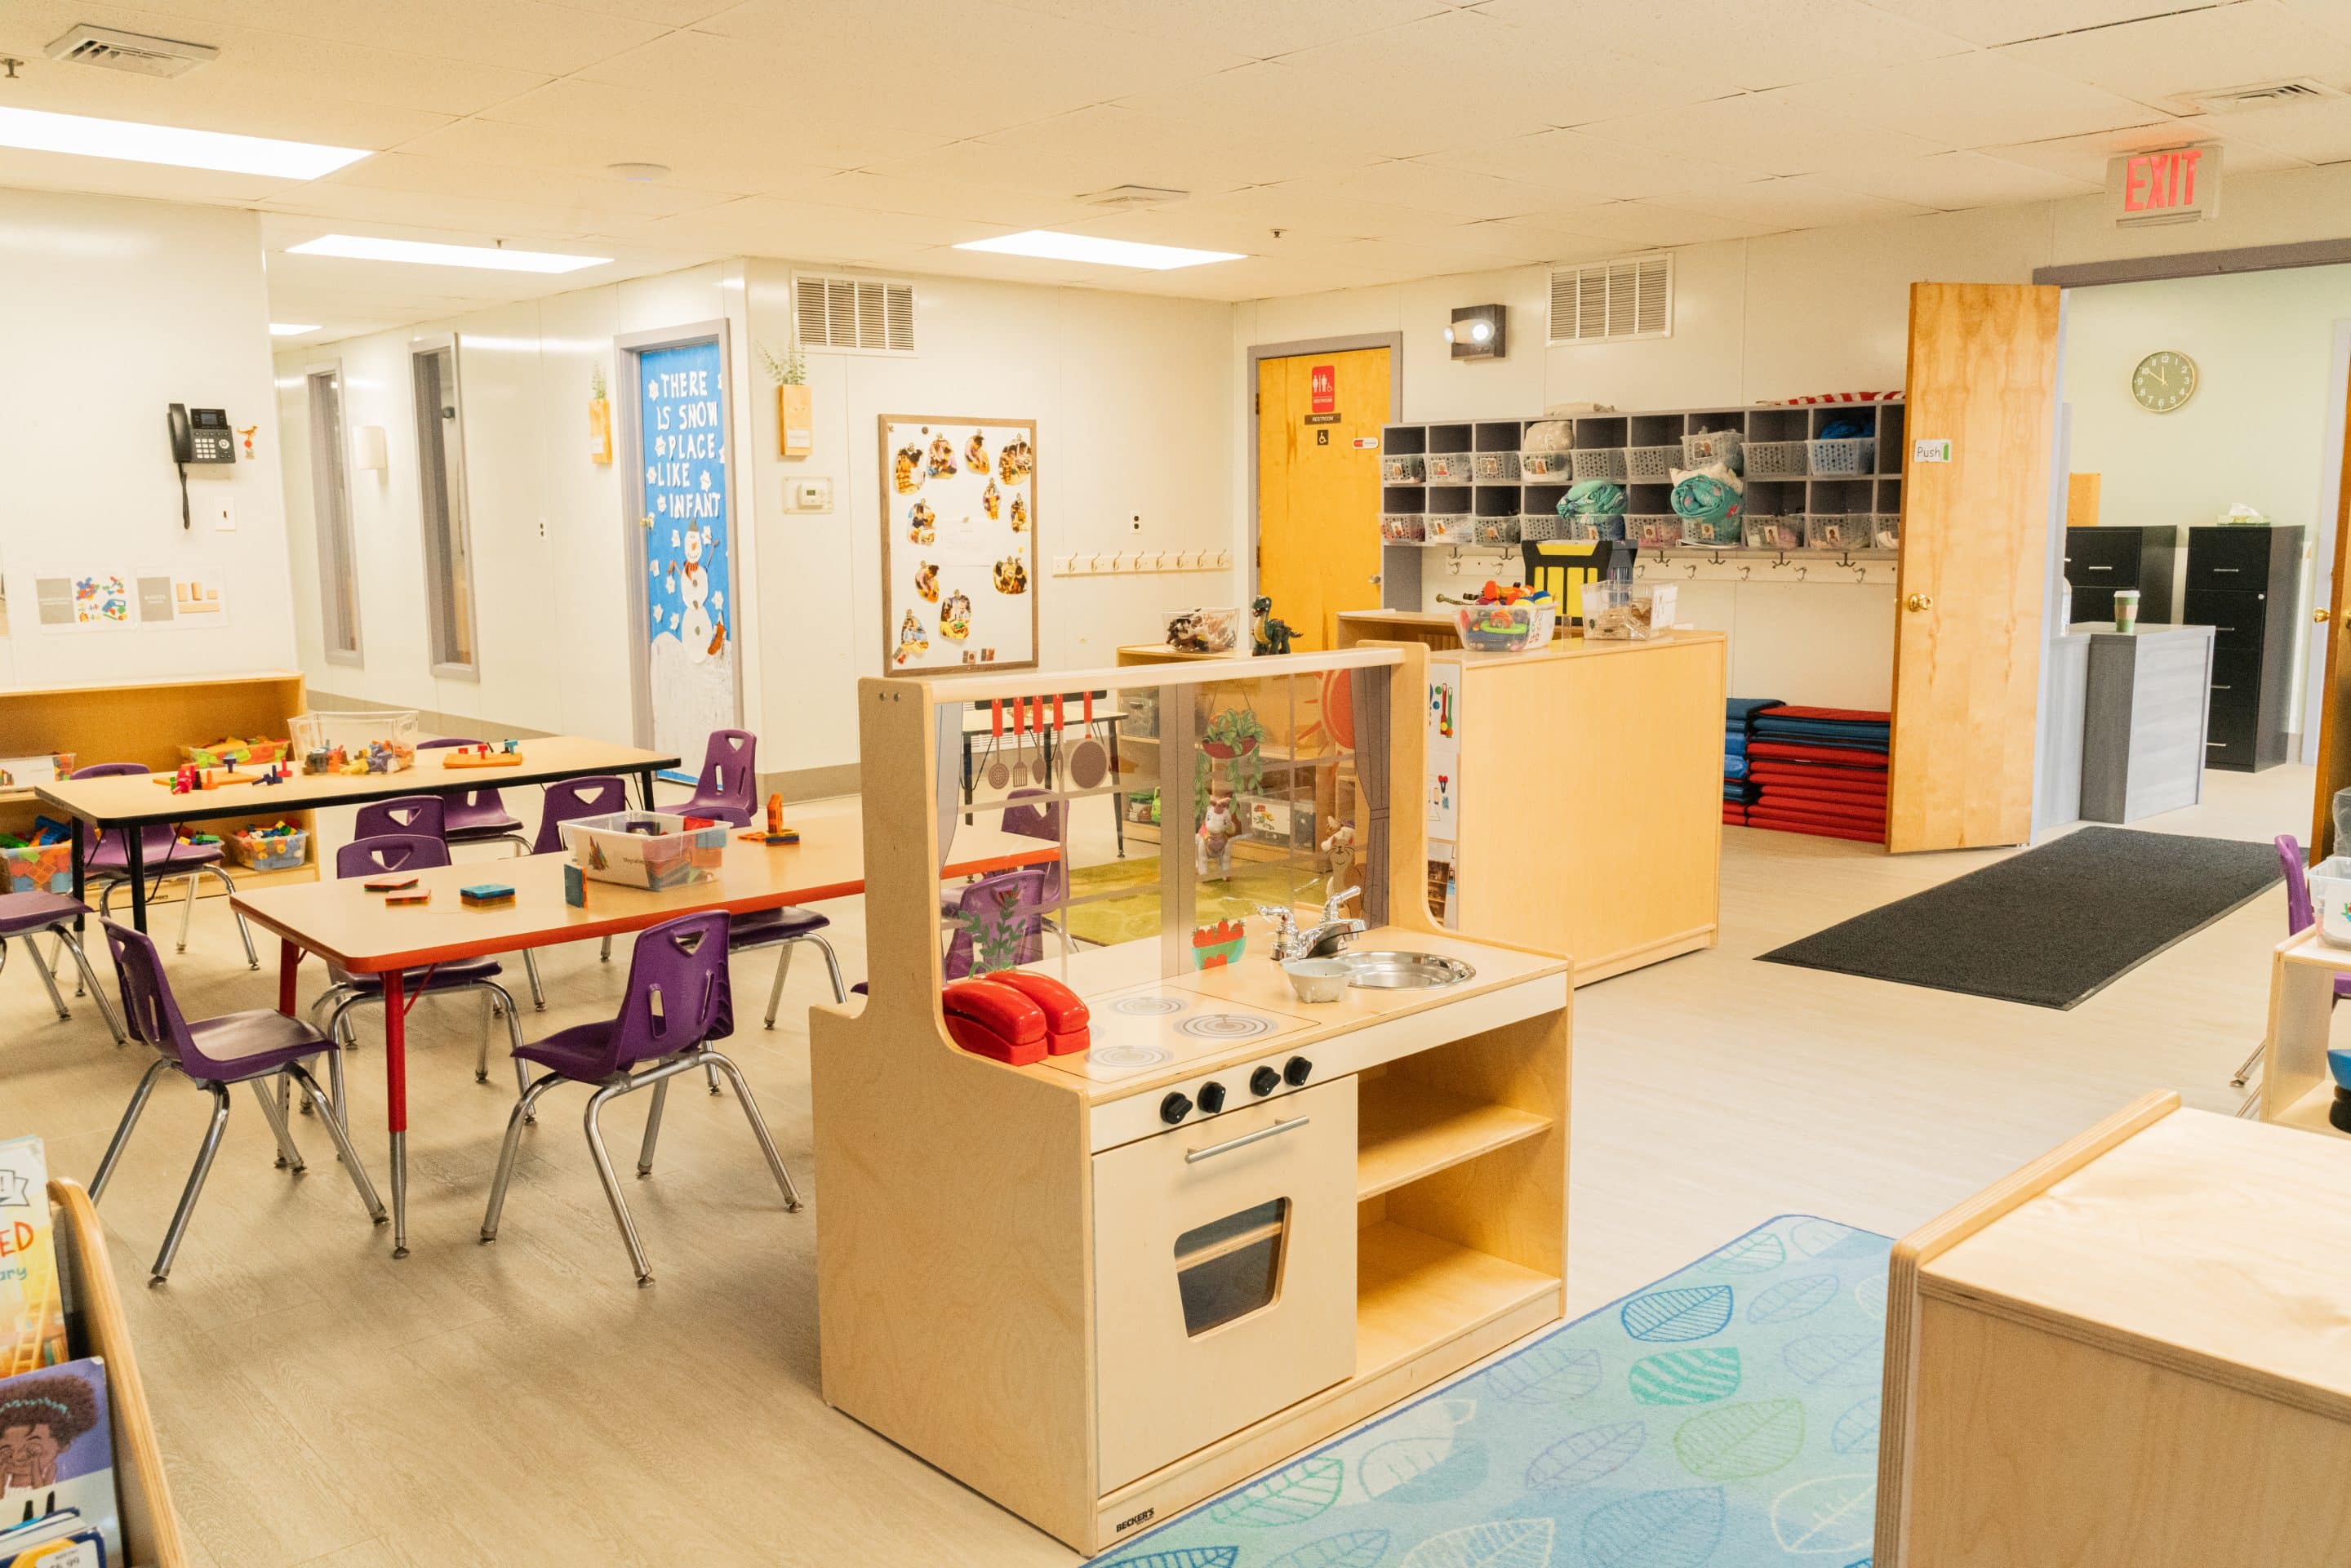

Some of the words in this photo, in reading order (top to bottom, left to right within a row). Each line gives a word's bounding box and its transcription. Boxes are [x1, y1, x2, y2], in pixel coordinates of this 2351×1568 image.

[2125, 150, 2202, 212] EXIT
[660, 371, 708, 398] THERE
[656, 405, 671, 431] IS
[679, 401, 718, 430] SNOW
[669, 433, 716, 460] PLACE
[1917, 446, 1940, 458] Push
[658, 462, 691, 487] LIKE
[669, 491, 721, 519] INFANT
[1116, 1507, 1155, 1533] BECKER'S
